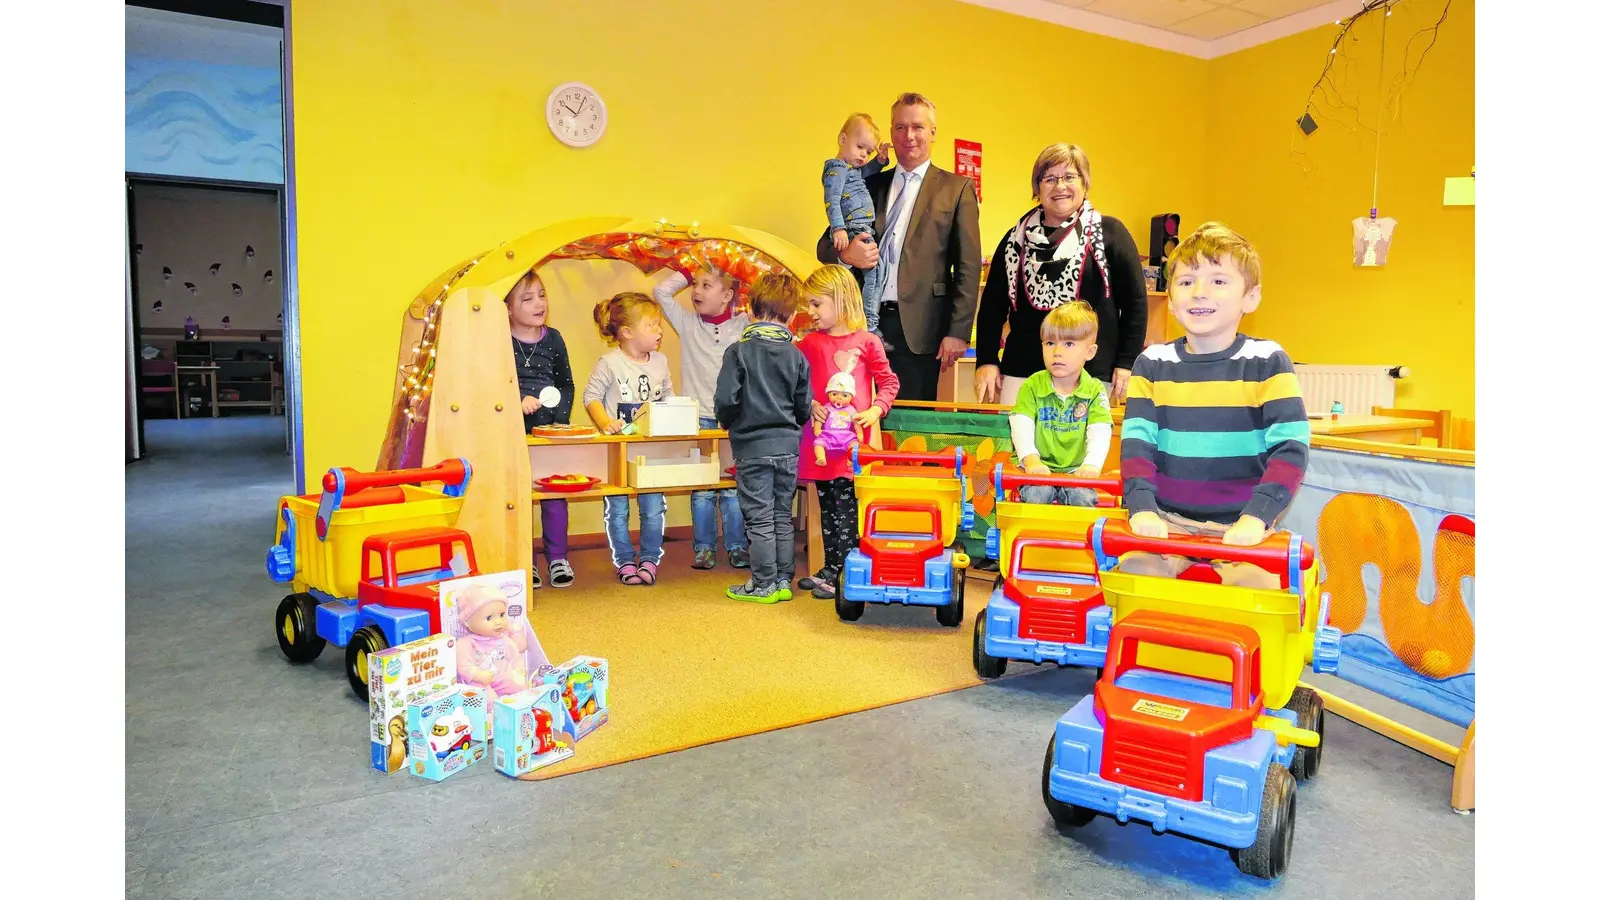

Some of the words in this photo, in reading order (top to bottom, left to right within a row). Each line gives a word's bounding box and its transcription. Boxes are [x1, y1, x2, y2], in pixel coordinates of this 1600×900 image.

[410, 647, 438, 662] Mein
[412, 659, 437, 673] Tier
[407, 674, 421, 685] zu
[425, 666, 445, 680] mir
